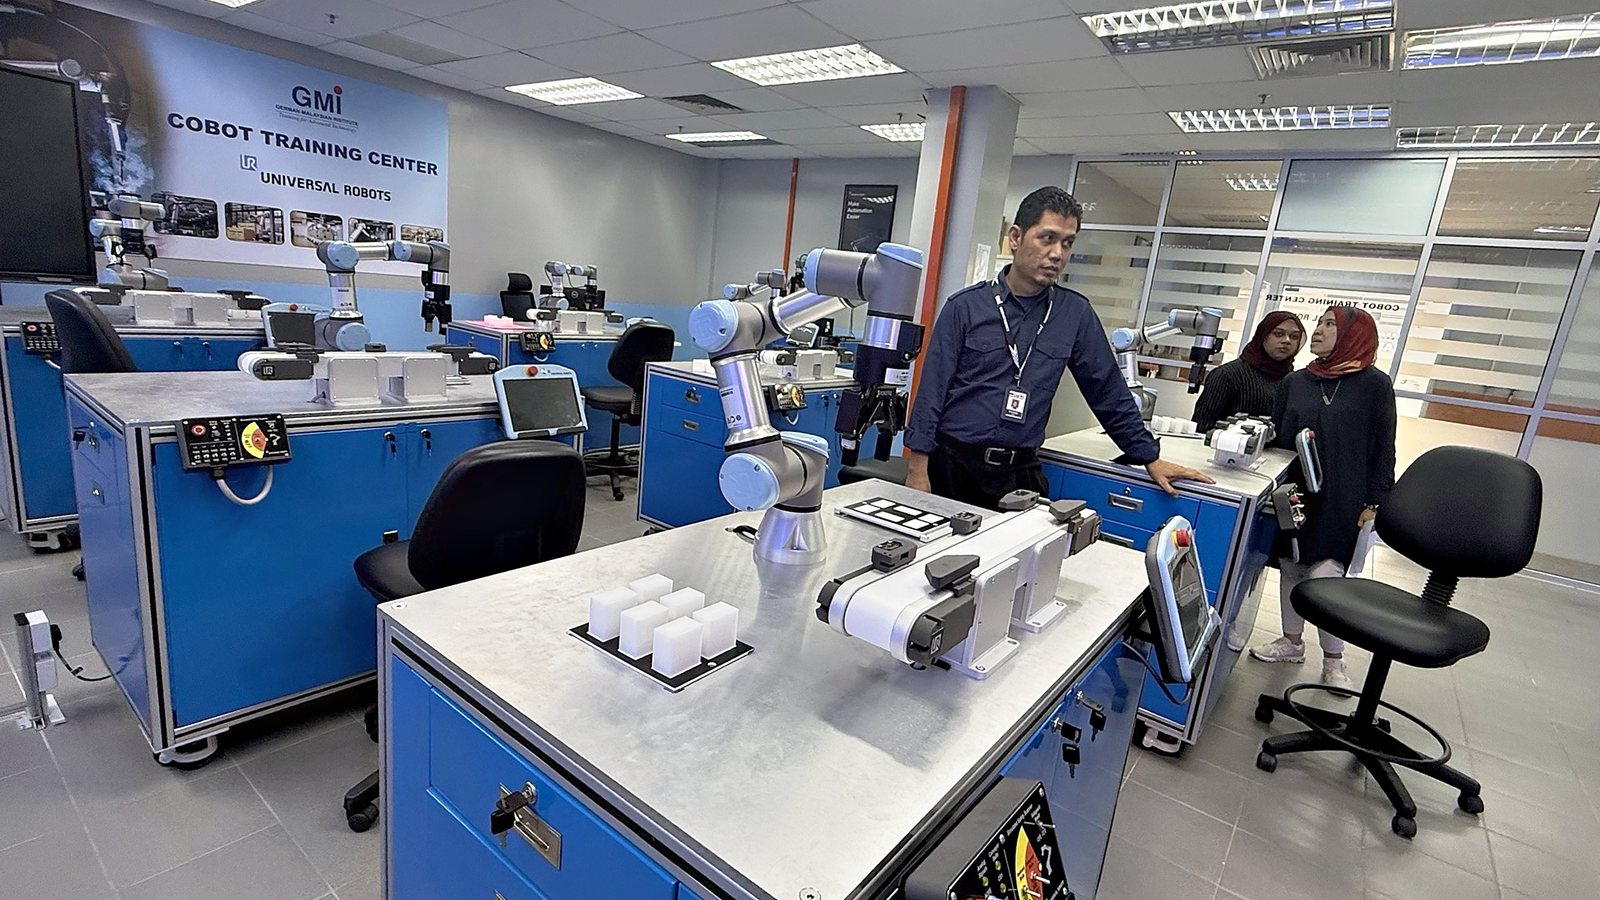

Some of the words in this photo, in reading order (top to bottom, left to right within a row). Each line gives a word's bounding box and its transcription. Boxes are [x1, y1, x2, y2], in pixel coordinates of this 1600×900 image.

[167, 112, 253, 141] COBOT
[260, 130, 362, 161] TRAINING
[368, 151, 438, 176] CENTER
[260, 171, 340, 194] UNIVERSAL
[343, 184, 392, 202] ROBOTS
